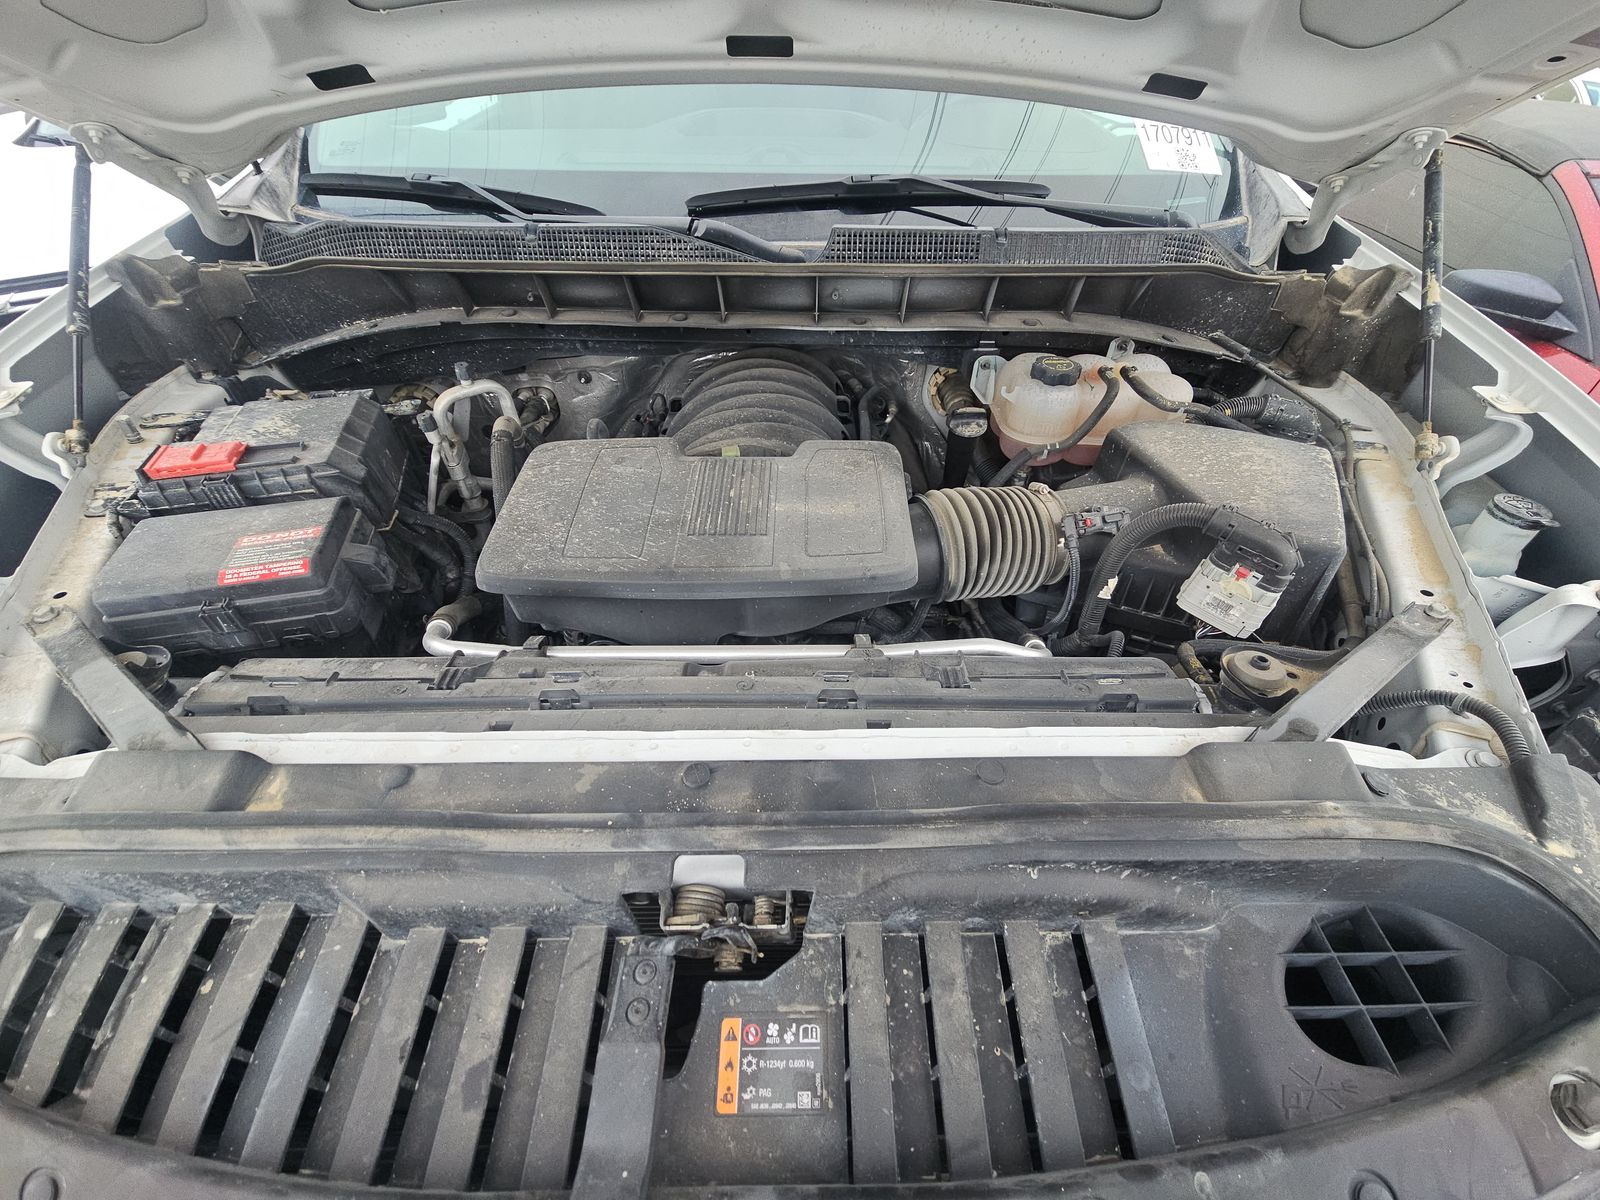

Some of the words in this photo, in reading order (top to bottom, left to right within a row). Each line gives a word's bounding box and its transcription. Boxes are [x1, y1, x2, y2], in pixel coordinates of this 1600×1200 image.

[1141, 124, 1210, 148] 1707911
[242, 535, 272, 543] DO
[276, 529, 316, 539] NOT
[225, 566, 264, 574] ODOMETER
[265, 560, 304, 568] TAMPERING
[240, 569, 270, 577] FEDERAL
[766, 1036, 780, 1044] AUTO
[760, 1059, 786, 1069] R-1234yf
[806, 1059, 814, 1069] kg
[759, 1088, 772, 1097] PAG
